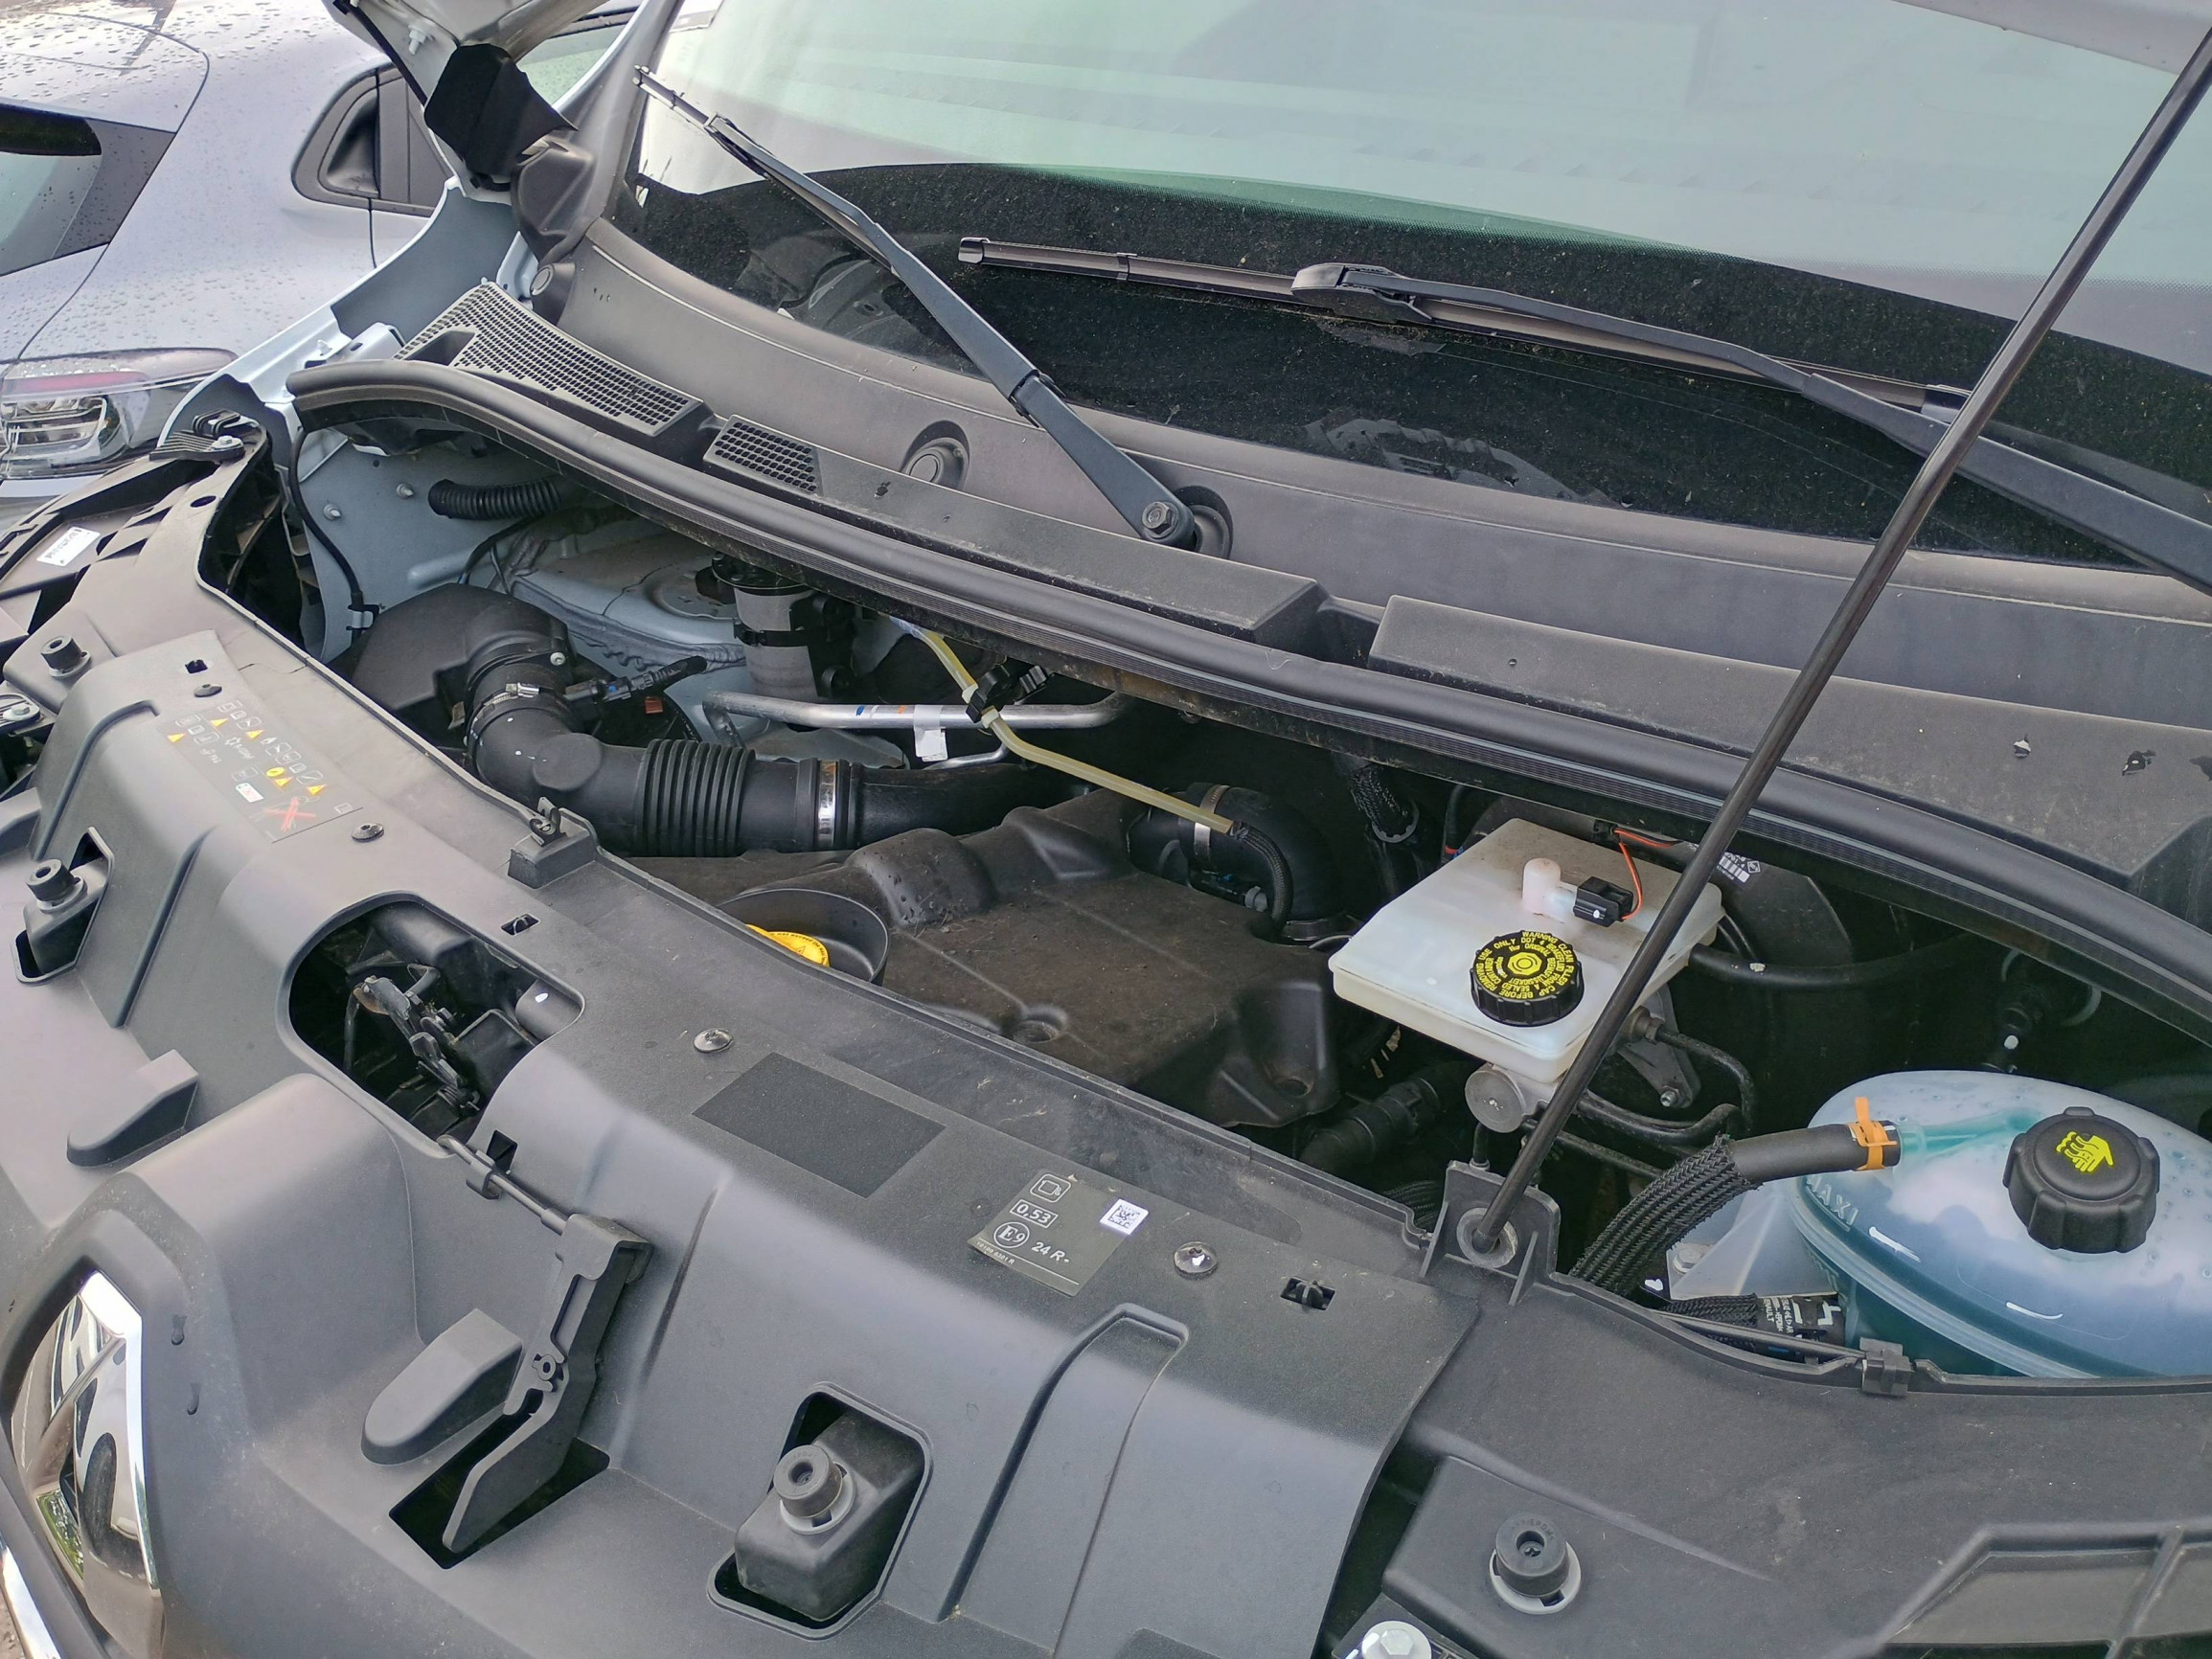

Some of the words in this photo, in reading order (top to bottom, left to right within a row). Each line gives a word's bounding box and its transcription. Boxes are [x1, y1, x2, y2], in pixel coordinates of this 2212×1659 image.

[1494, 939, 1516, 949] ONLY
[1522, 931, 1558, 943] WARNING
[1478, 948, 1493, 961] USE
[1525, 943, 1551, 957] ORIGINAL
[1558, 943, 1574, 963] CLEAN
[1476, 964, 1497, 991] REMOVING
[1540, 972, 1561, 987] FROM
[1558, 966, 1574, 986] FILLER
[1499, 989, 1533, 999] BEFORE
[1502, 982, 1530, 992] SEALED
[1539, 986, 1556, 996] CAP
[1807, 1175, 1859, 1226] MAXI
[1016, 1203, 1052, 1224] 0,53
[998, 1225, 1026, 1242] E9
[1031, 1241, 1051, 1255] 24
